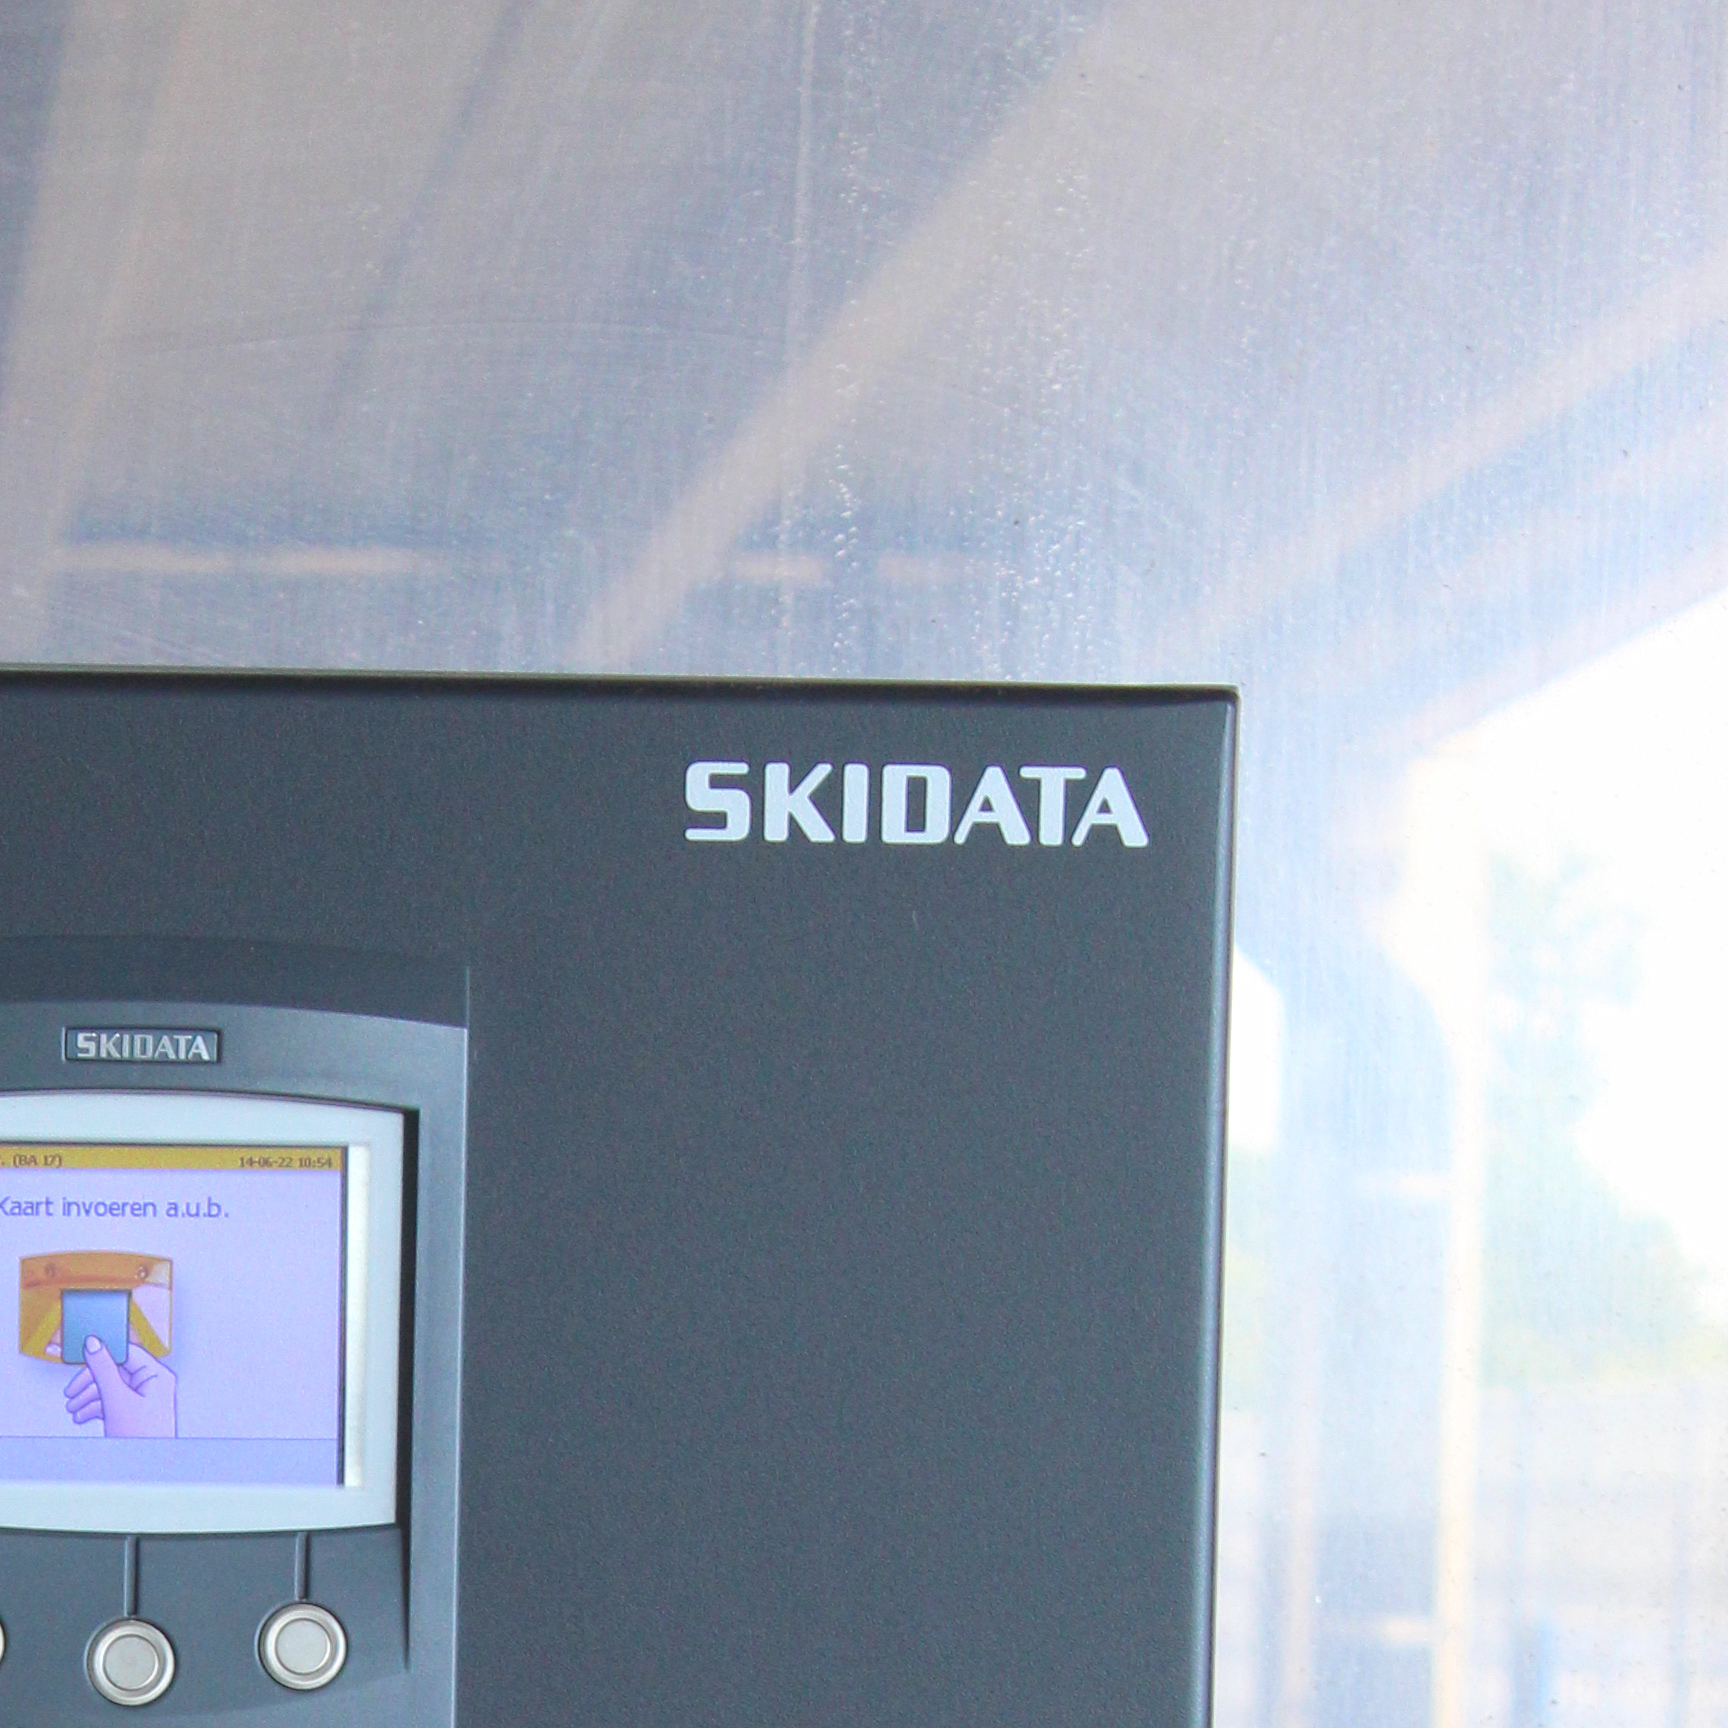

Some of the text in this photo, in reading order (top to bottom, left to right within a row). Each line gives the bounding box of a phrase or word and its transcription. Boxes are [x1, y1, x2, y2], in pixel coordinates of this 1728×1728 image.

[684, 760, 1150, 848] SKIDATA
[76, 1032, 212, 1061] SKIDATA
[12, 1154, 38, 1168] (BA
[62, 1196, 157, 1218] invoeren
[166, 1197, 229, 1218] a.u.b.
